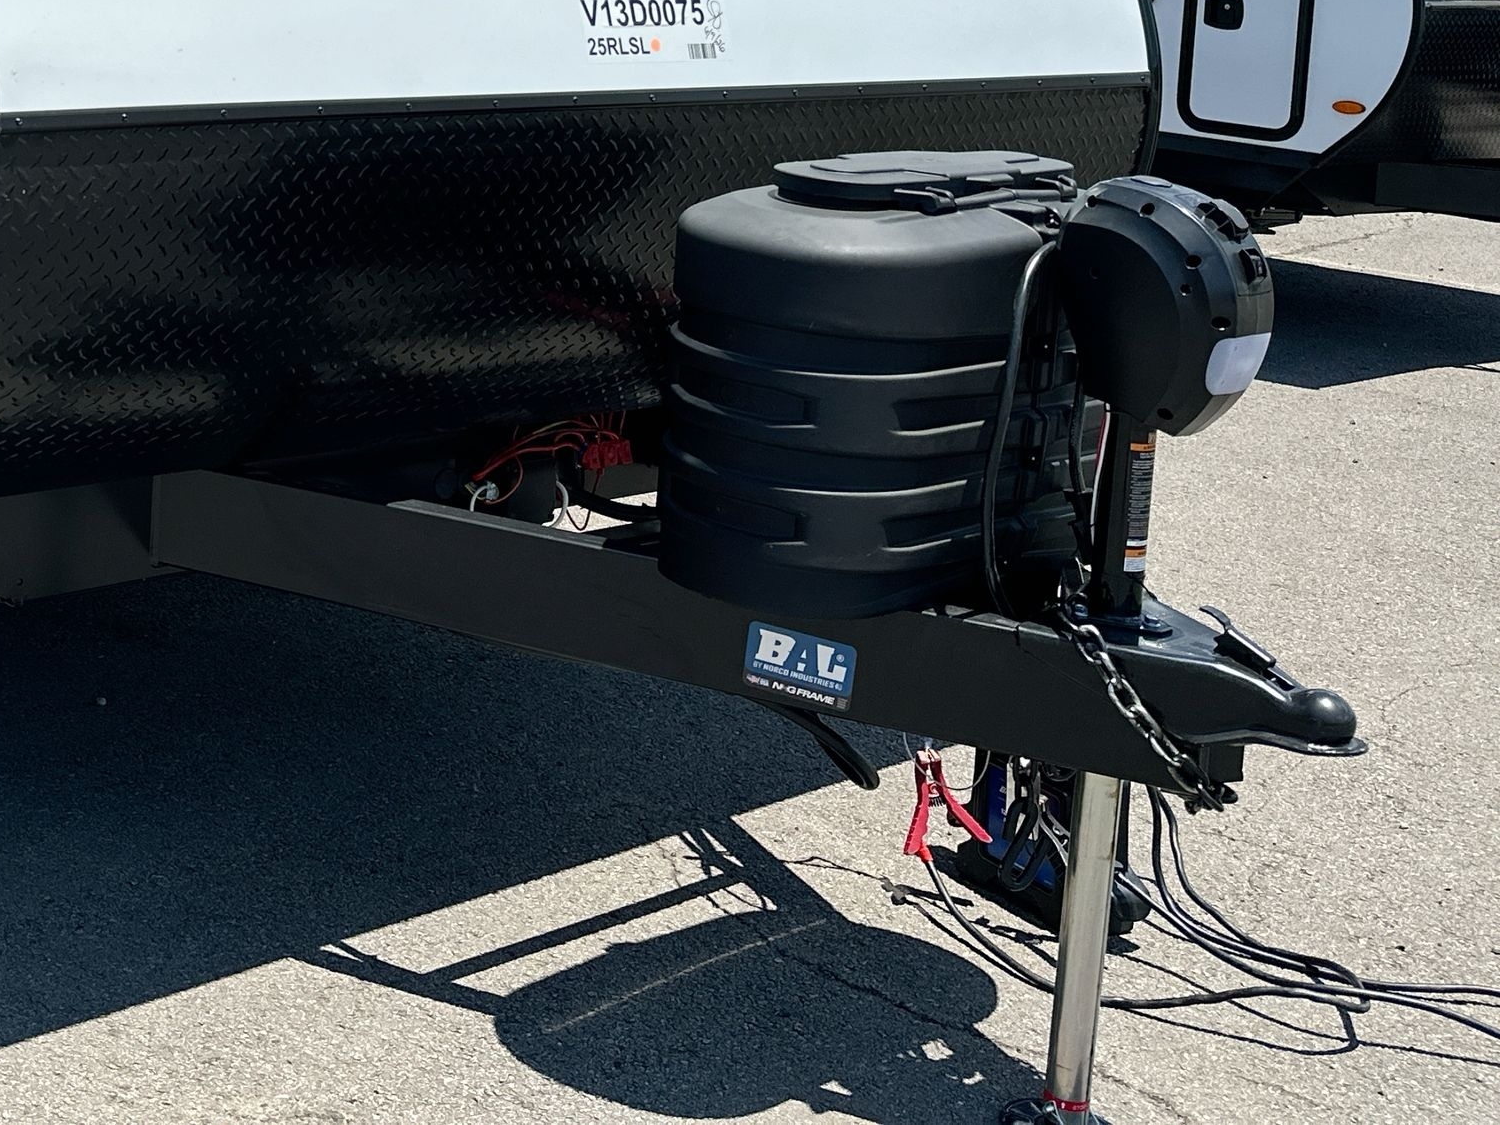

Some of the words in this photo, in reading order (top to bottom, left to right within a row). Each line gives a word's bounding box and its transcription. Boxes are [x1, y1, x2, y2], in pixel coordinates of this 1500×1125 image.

[587, 37, 650, 55] 25RLSL
[752, 660, 762, 669] BY
[762, 663, 790, 676] NORCO
[790, 669, 836, 689] INDUSTRIES
[796, 689, 836, 705] FRAME
